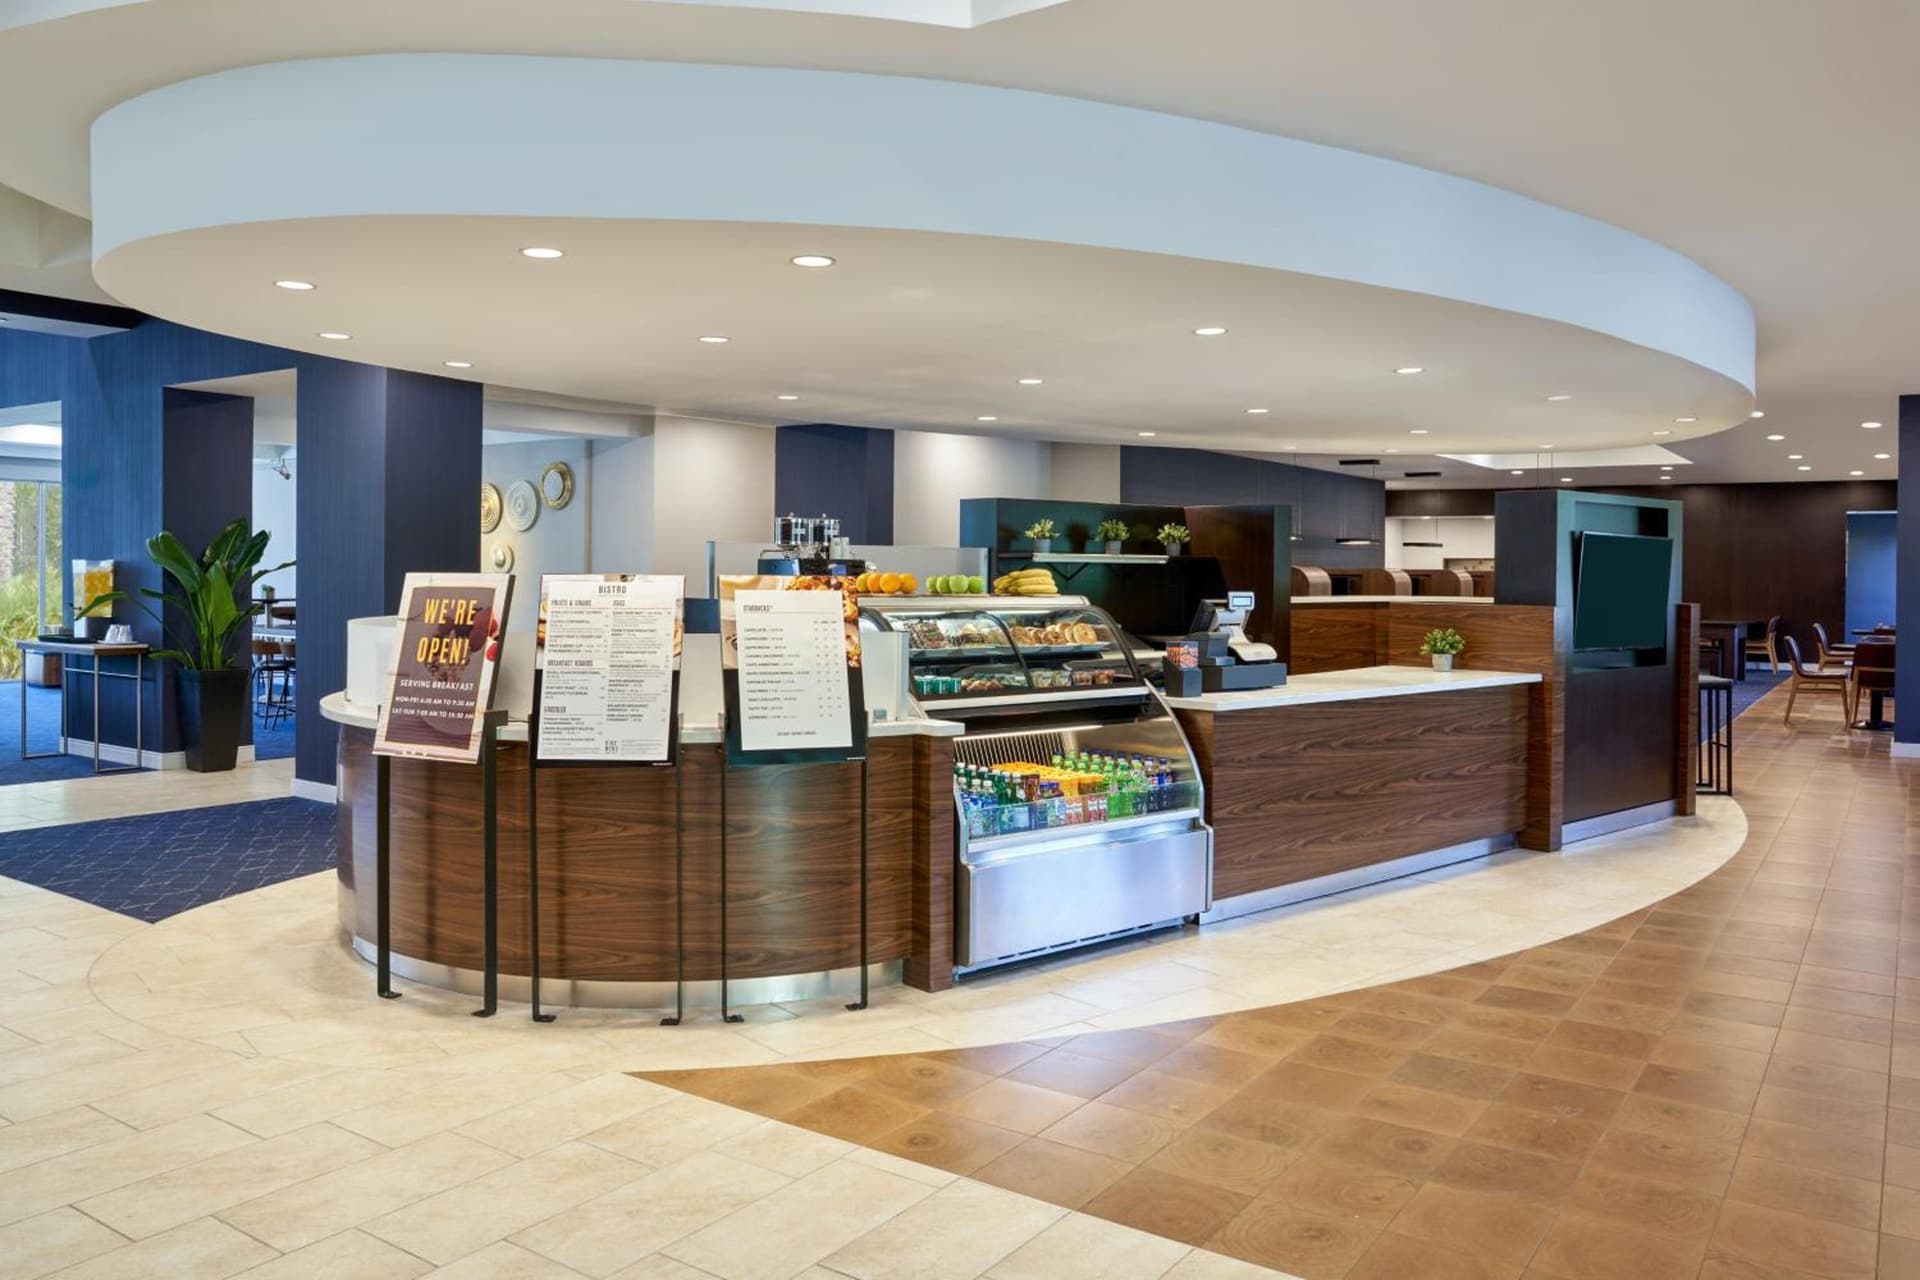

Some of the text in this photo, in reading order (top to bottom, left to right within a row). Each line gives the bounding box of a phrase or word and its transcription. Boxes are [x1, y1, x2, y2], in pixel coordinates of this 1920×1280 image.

[598, 585, 627, 594] BISTRO
[424, 598, 478, 625] WE'RE
[416, 637, 470, 664] OPEN!
[399, 679, 475, 691] SERVING BREAKFAST
